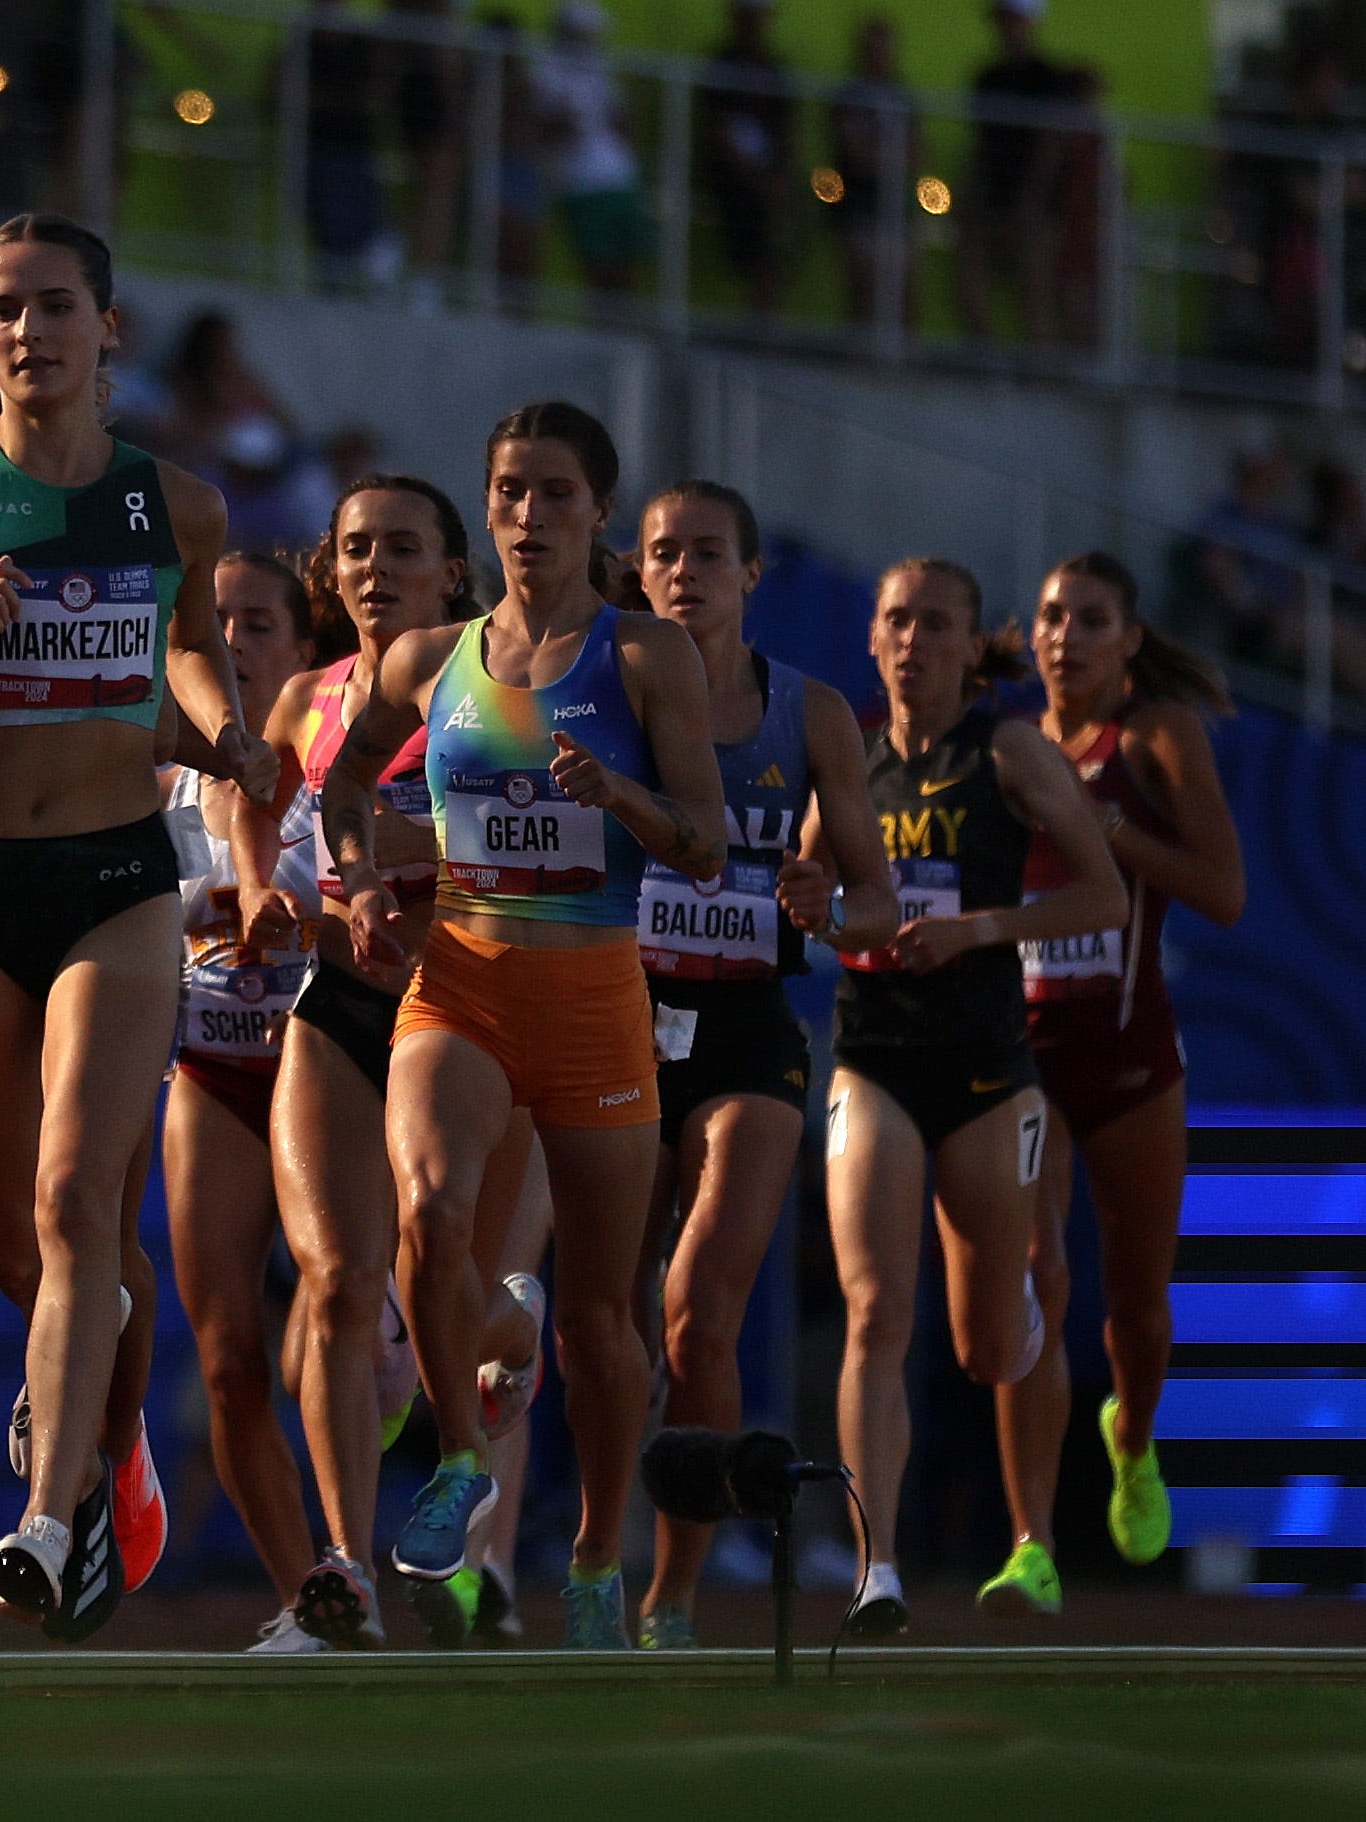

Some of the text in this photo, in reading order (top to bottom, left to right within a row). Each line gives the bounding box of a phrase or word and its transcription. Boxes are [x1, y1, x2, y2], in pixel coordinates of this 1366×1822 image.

[554, 702, 597, 720] HOKA
[486, 816, 559, 852] GEAR
[99, 860, 142, 881] OAC
[475, 879, 497, 888] 2024
[652, 902, 755, 941] BALOGA
[201, 1010, 280, 1042] SCHR
[598, 1087, 642, 1108] HOKA
[1023, 1116, 1041, 1178] 7
